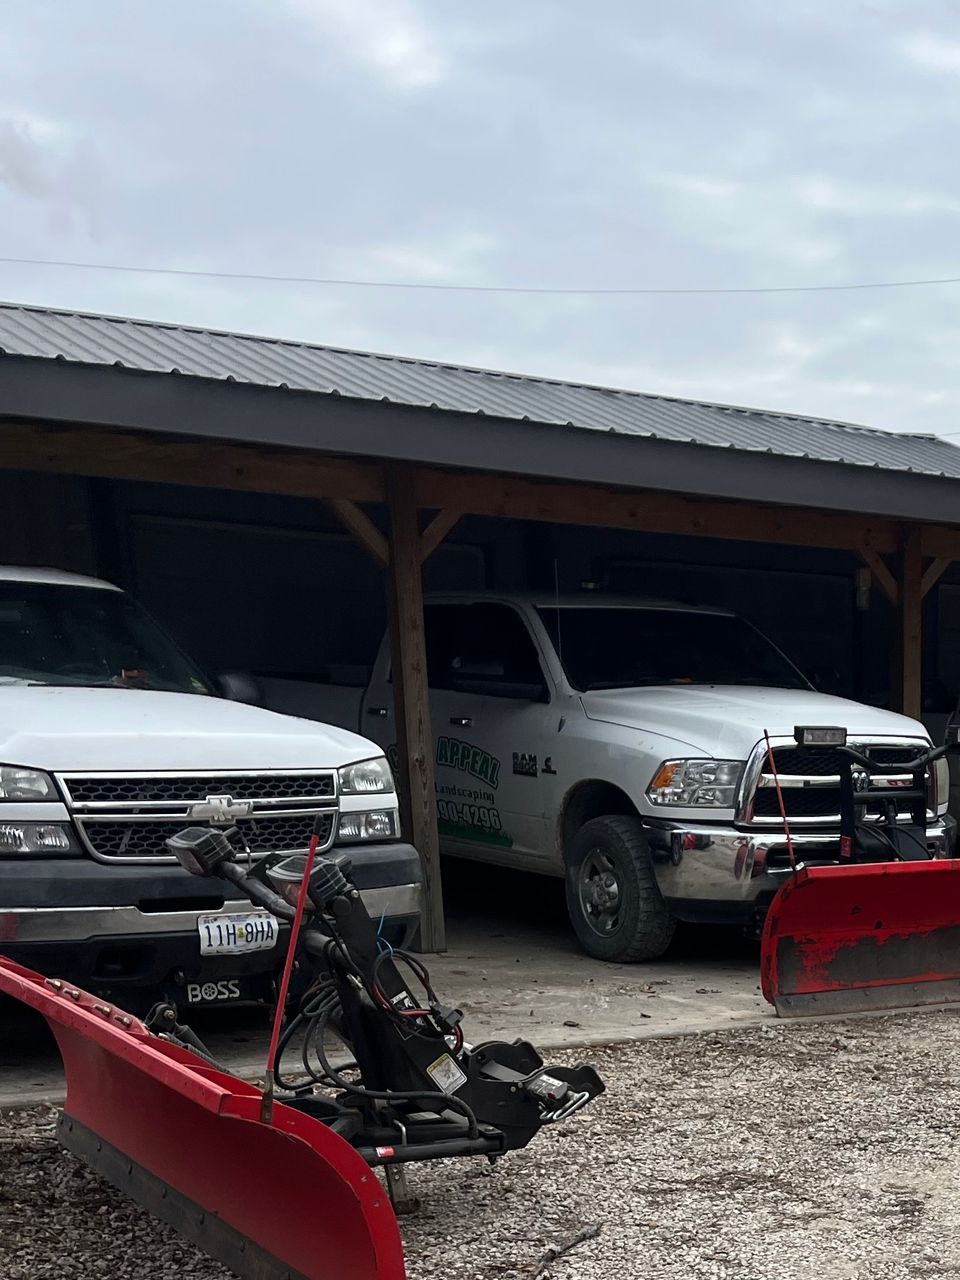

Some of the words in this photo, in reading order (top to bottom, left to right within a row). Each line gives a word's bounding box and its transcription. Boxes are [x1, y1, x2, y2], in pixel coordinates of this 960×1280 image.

[436, 736, 501, 789] APPEAL
[205, 924, 237, 948] 11H
[245, 920, 274, 943] 8HA
[187, 980, 241, 1003] BOSS
